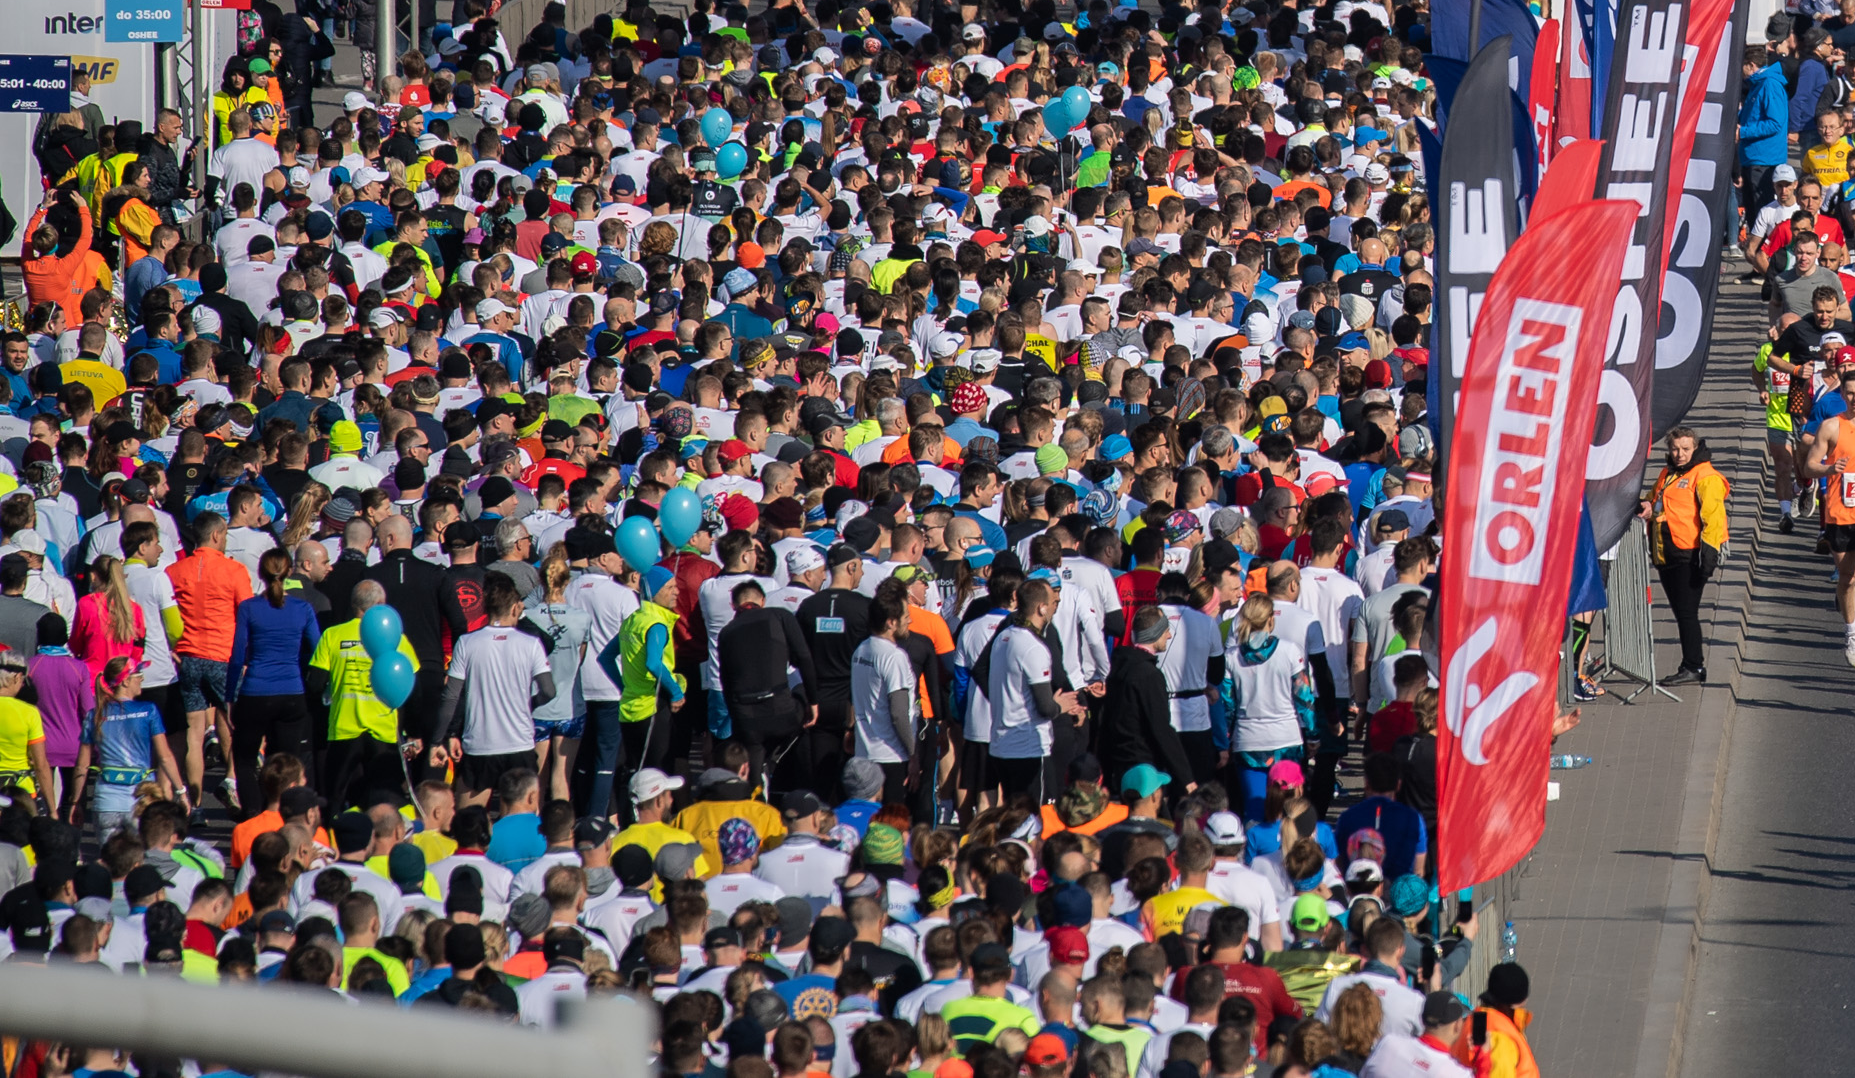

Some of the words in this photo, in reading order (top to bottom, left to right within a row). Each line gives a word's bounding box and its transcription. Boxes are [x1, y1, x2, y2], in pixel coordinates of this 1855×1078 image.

[116, 10, 132, 20] do
[135, 10, 171, 20] 35:00
[128, 31, 158, 39] OSHEE
[71, 61, 115, 81] MF
[33, 79, 66, 89] 40:00
[70, 370, 104, 379] LIETUVA
[1485, 318, 1568, 565] ORLEN
